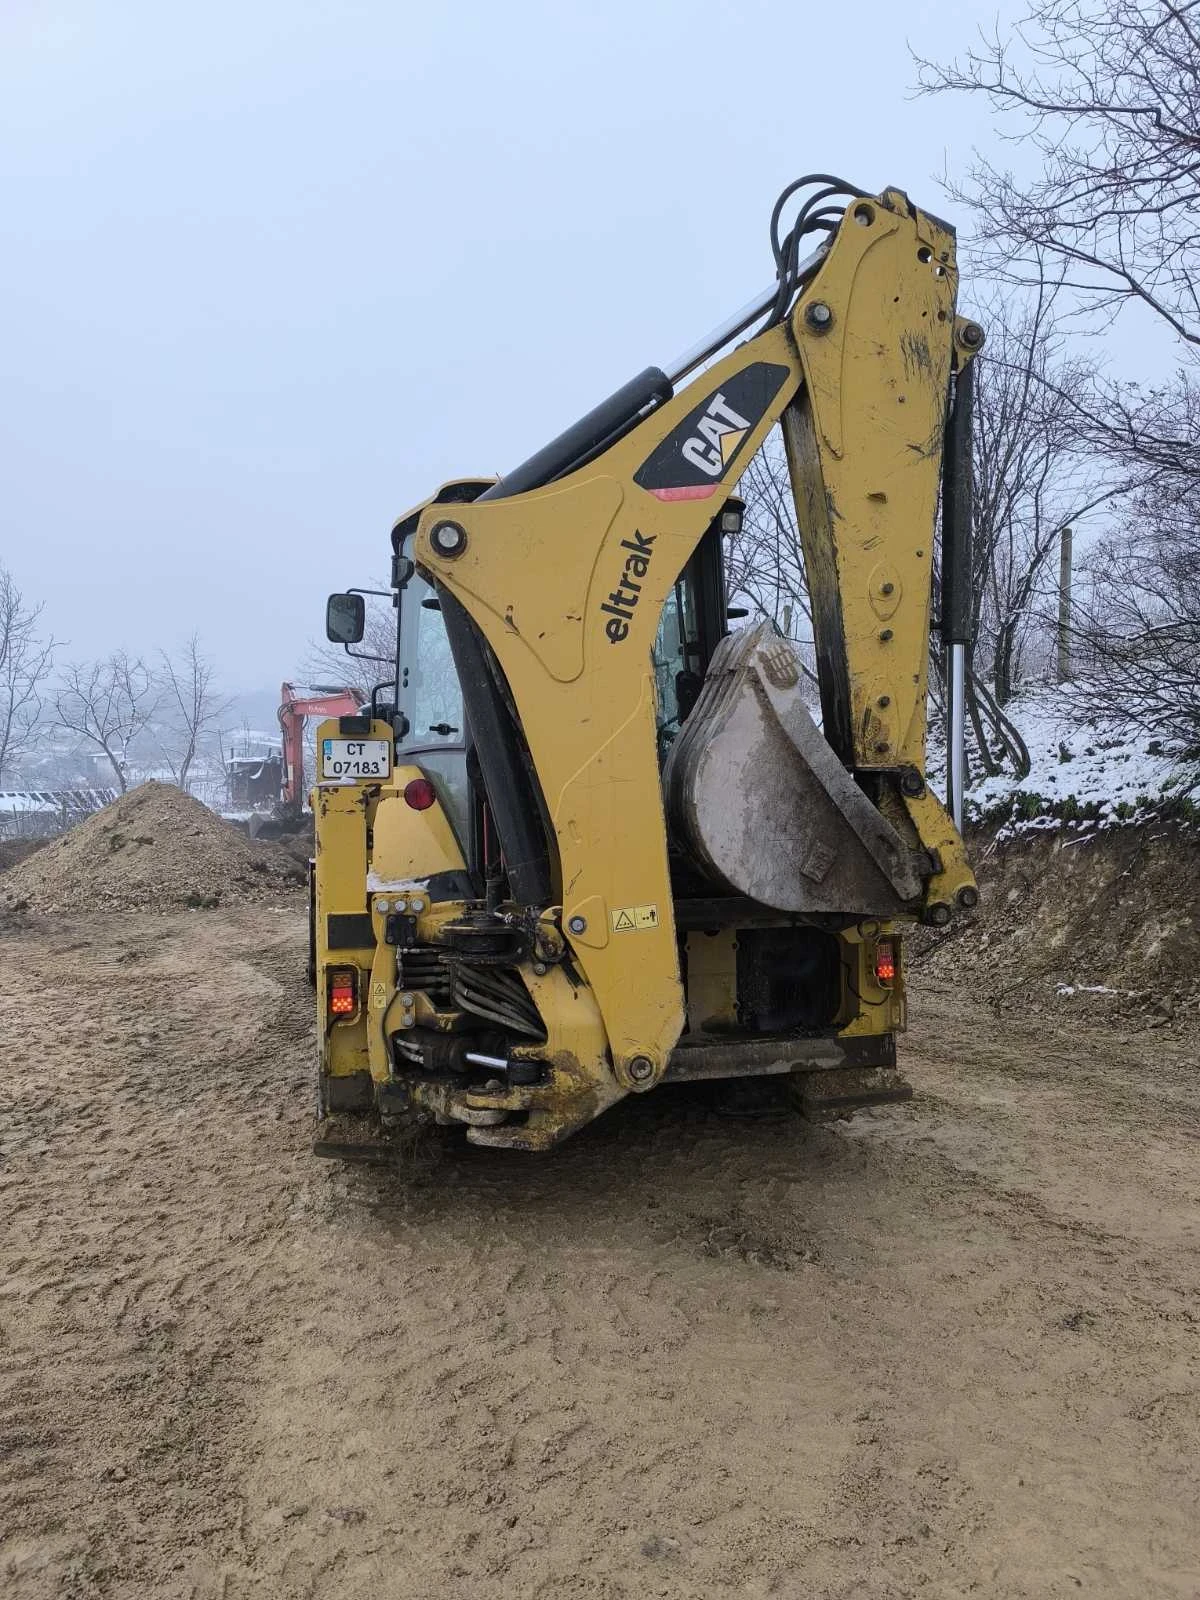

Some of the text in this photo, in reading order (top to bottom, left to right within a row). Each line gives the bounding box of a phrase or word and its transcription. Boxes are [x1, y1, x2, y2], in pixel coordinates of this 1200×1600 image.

[681, 393, 751, 477] CAT
[600, 528, 657, 644] eltrak
[333, 761, 380, 774] 07183
[347, 743, 366, 756] CT
